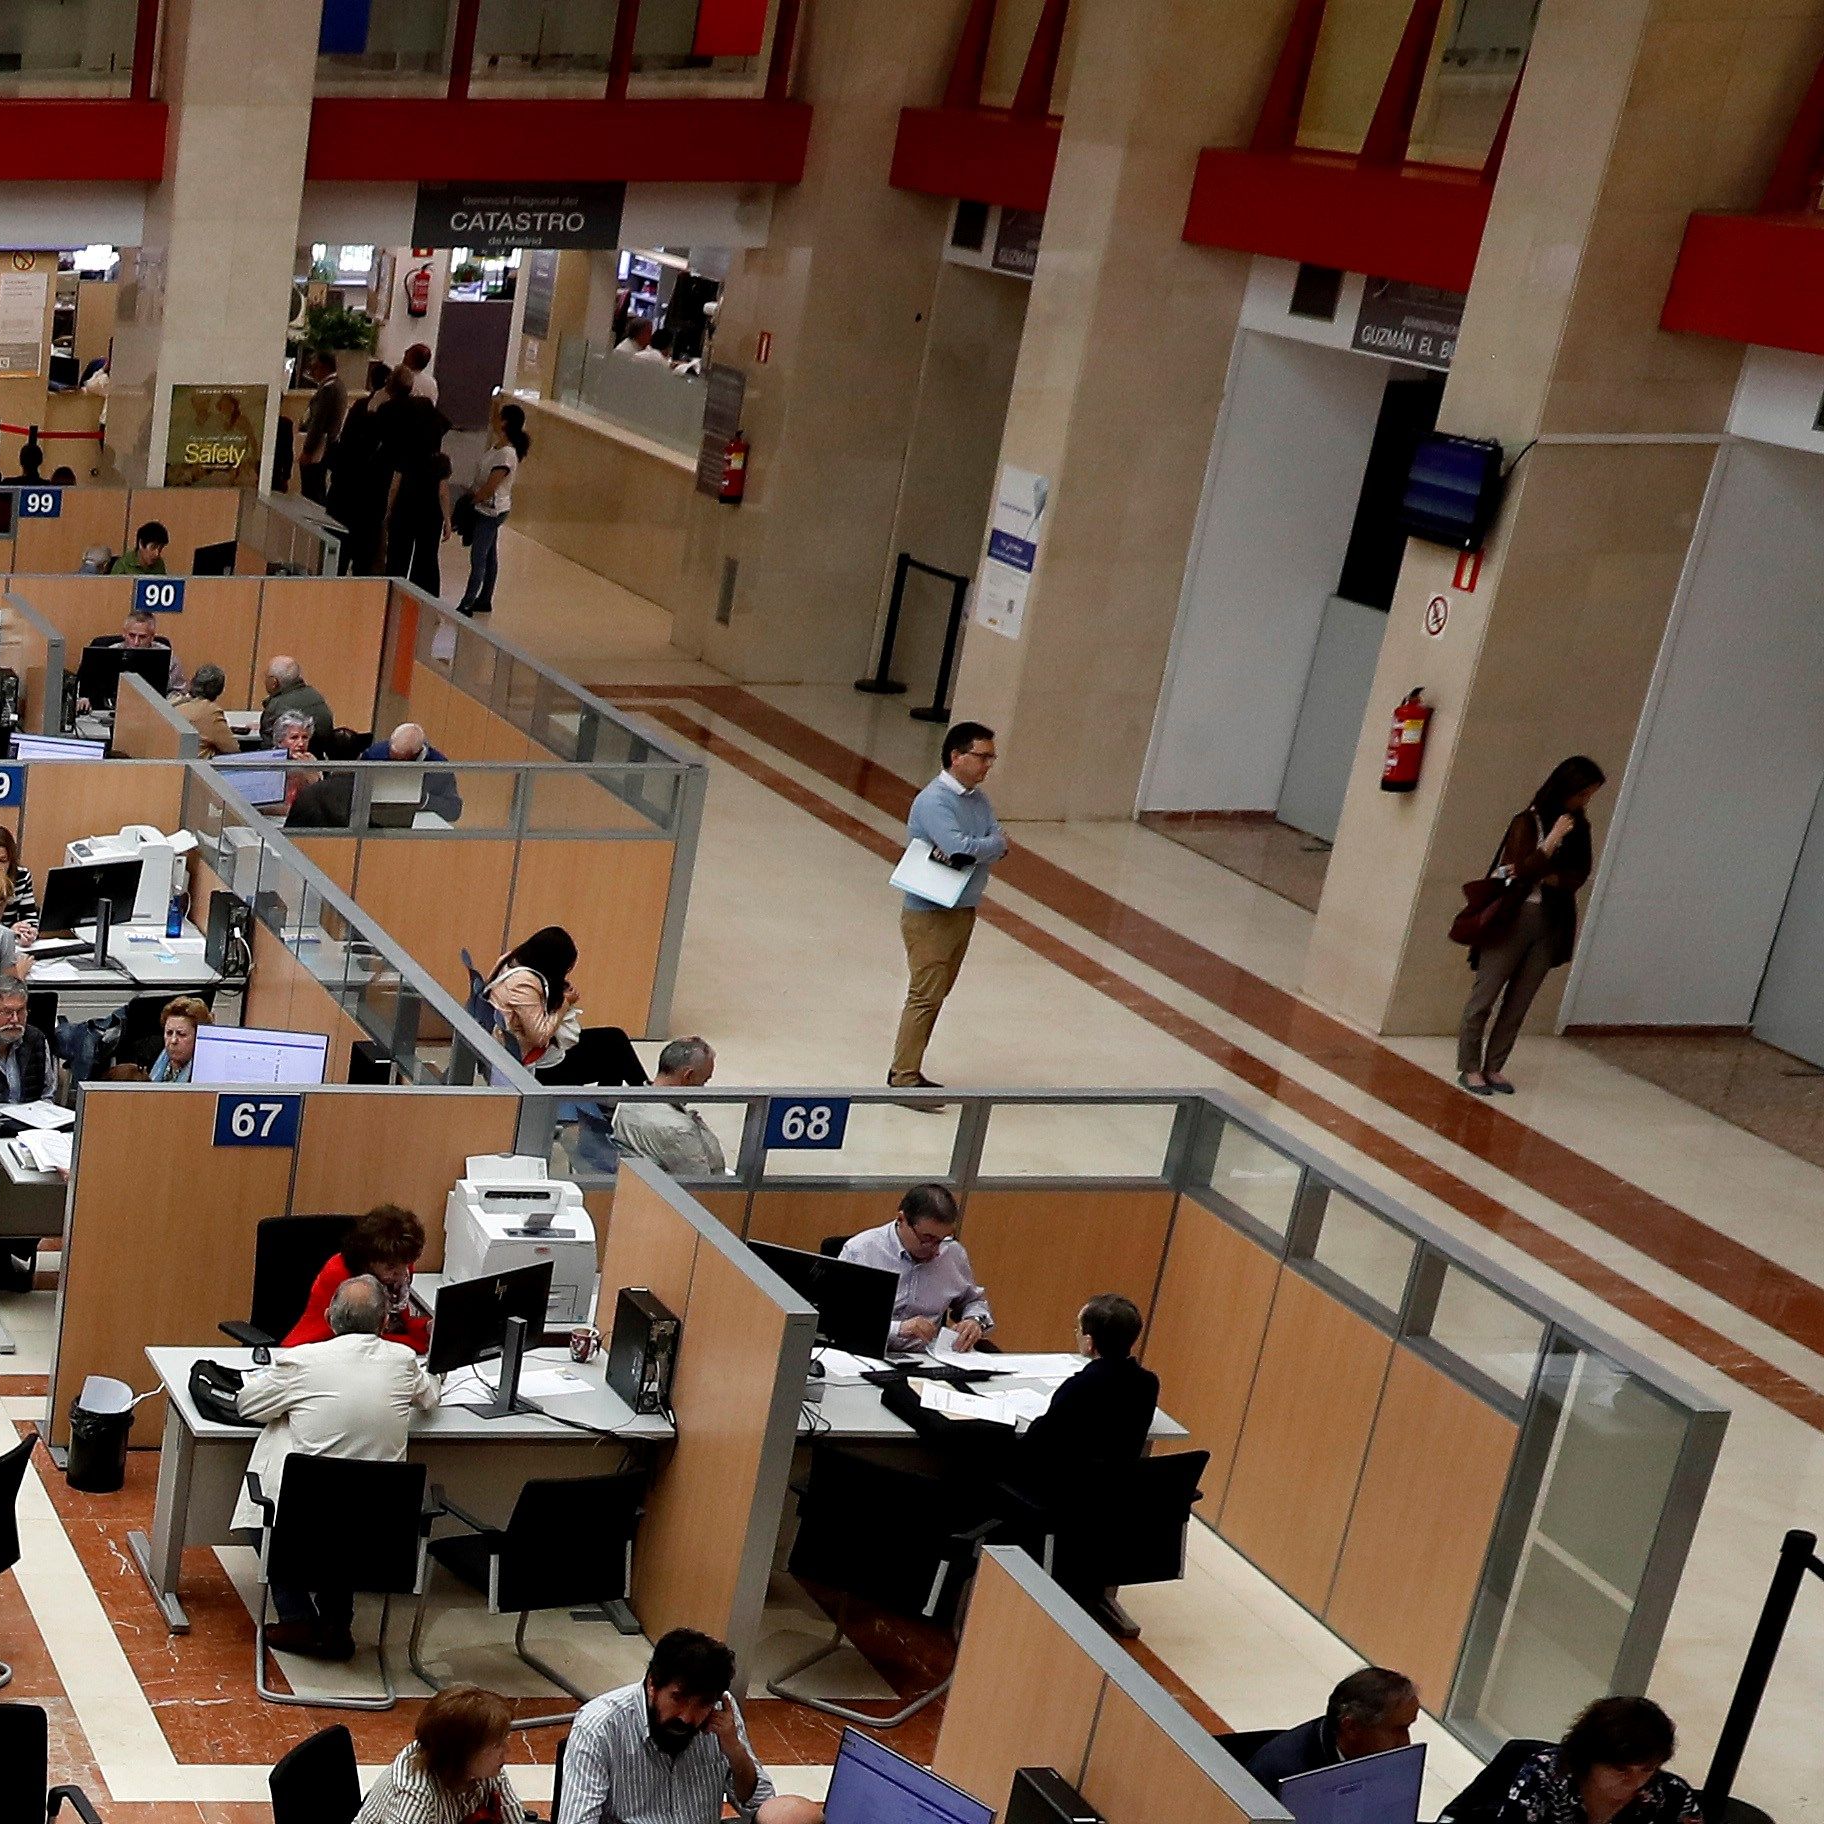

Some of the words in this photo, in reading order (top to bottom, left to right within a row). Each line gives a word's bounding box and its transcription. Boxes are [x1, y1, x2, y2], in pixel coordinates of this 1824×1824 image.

[451, 211, 584, 232] CATASTRO
[185, 443, 246, 469] Safety
[28, 494, 53, 512] 99
[146, 585, 174, 606] 90
[232, 1103, 282, 1136] 67
[782, 1106, 831, 1140] 68
